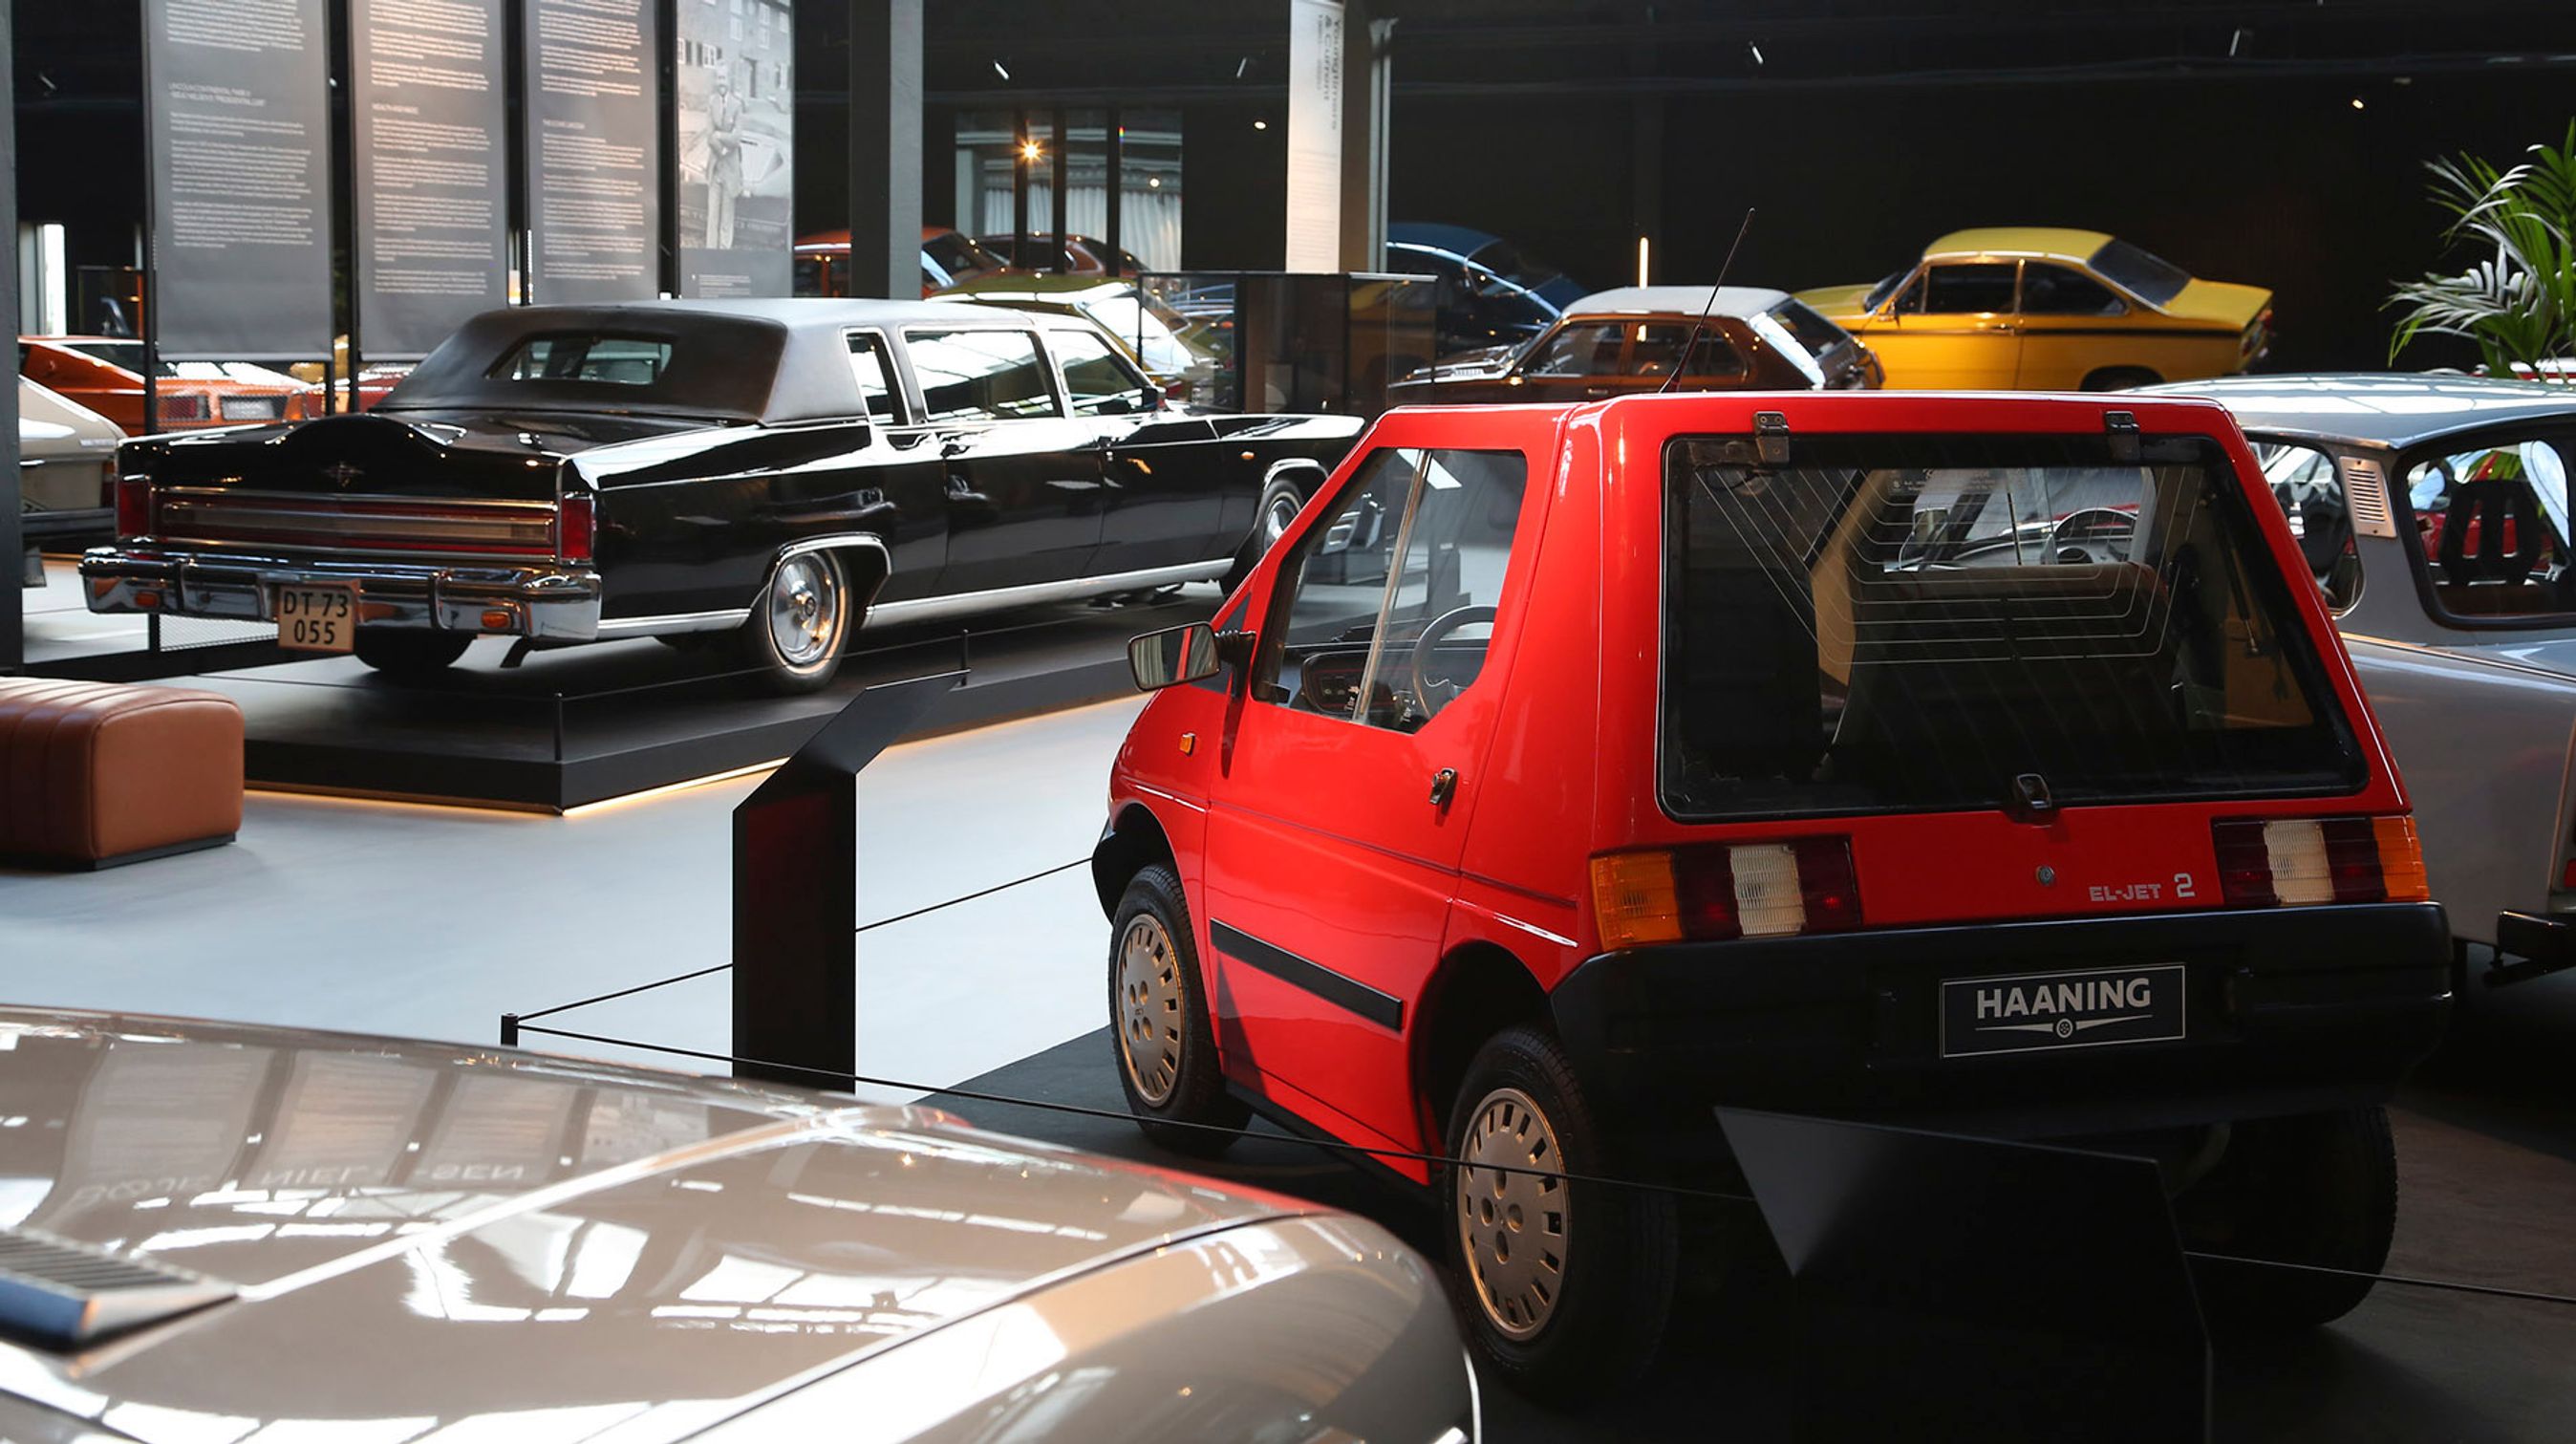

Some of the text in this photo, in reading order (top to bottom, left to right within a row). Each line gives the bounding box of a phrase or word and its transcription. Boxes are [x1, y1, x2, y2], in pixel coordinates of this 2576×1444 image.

[284, 591, 348, 617] DT 73
[294, 617, 335, 644] 055
[2089, 873, 2196, 901] EL-JET 2
[1976, 978, 2151, 1019] HAANING
